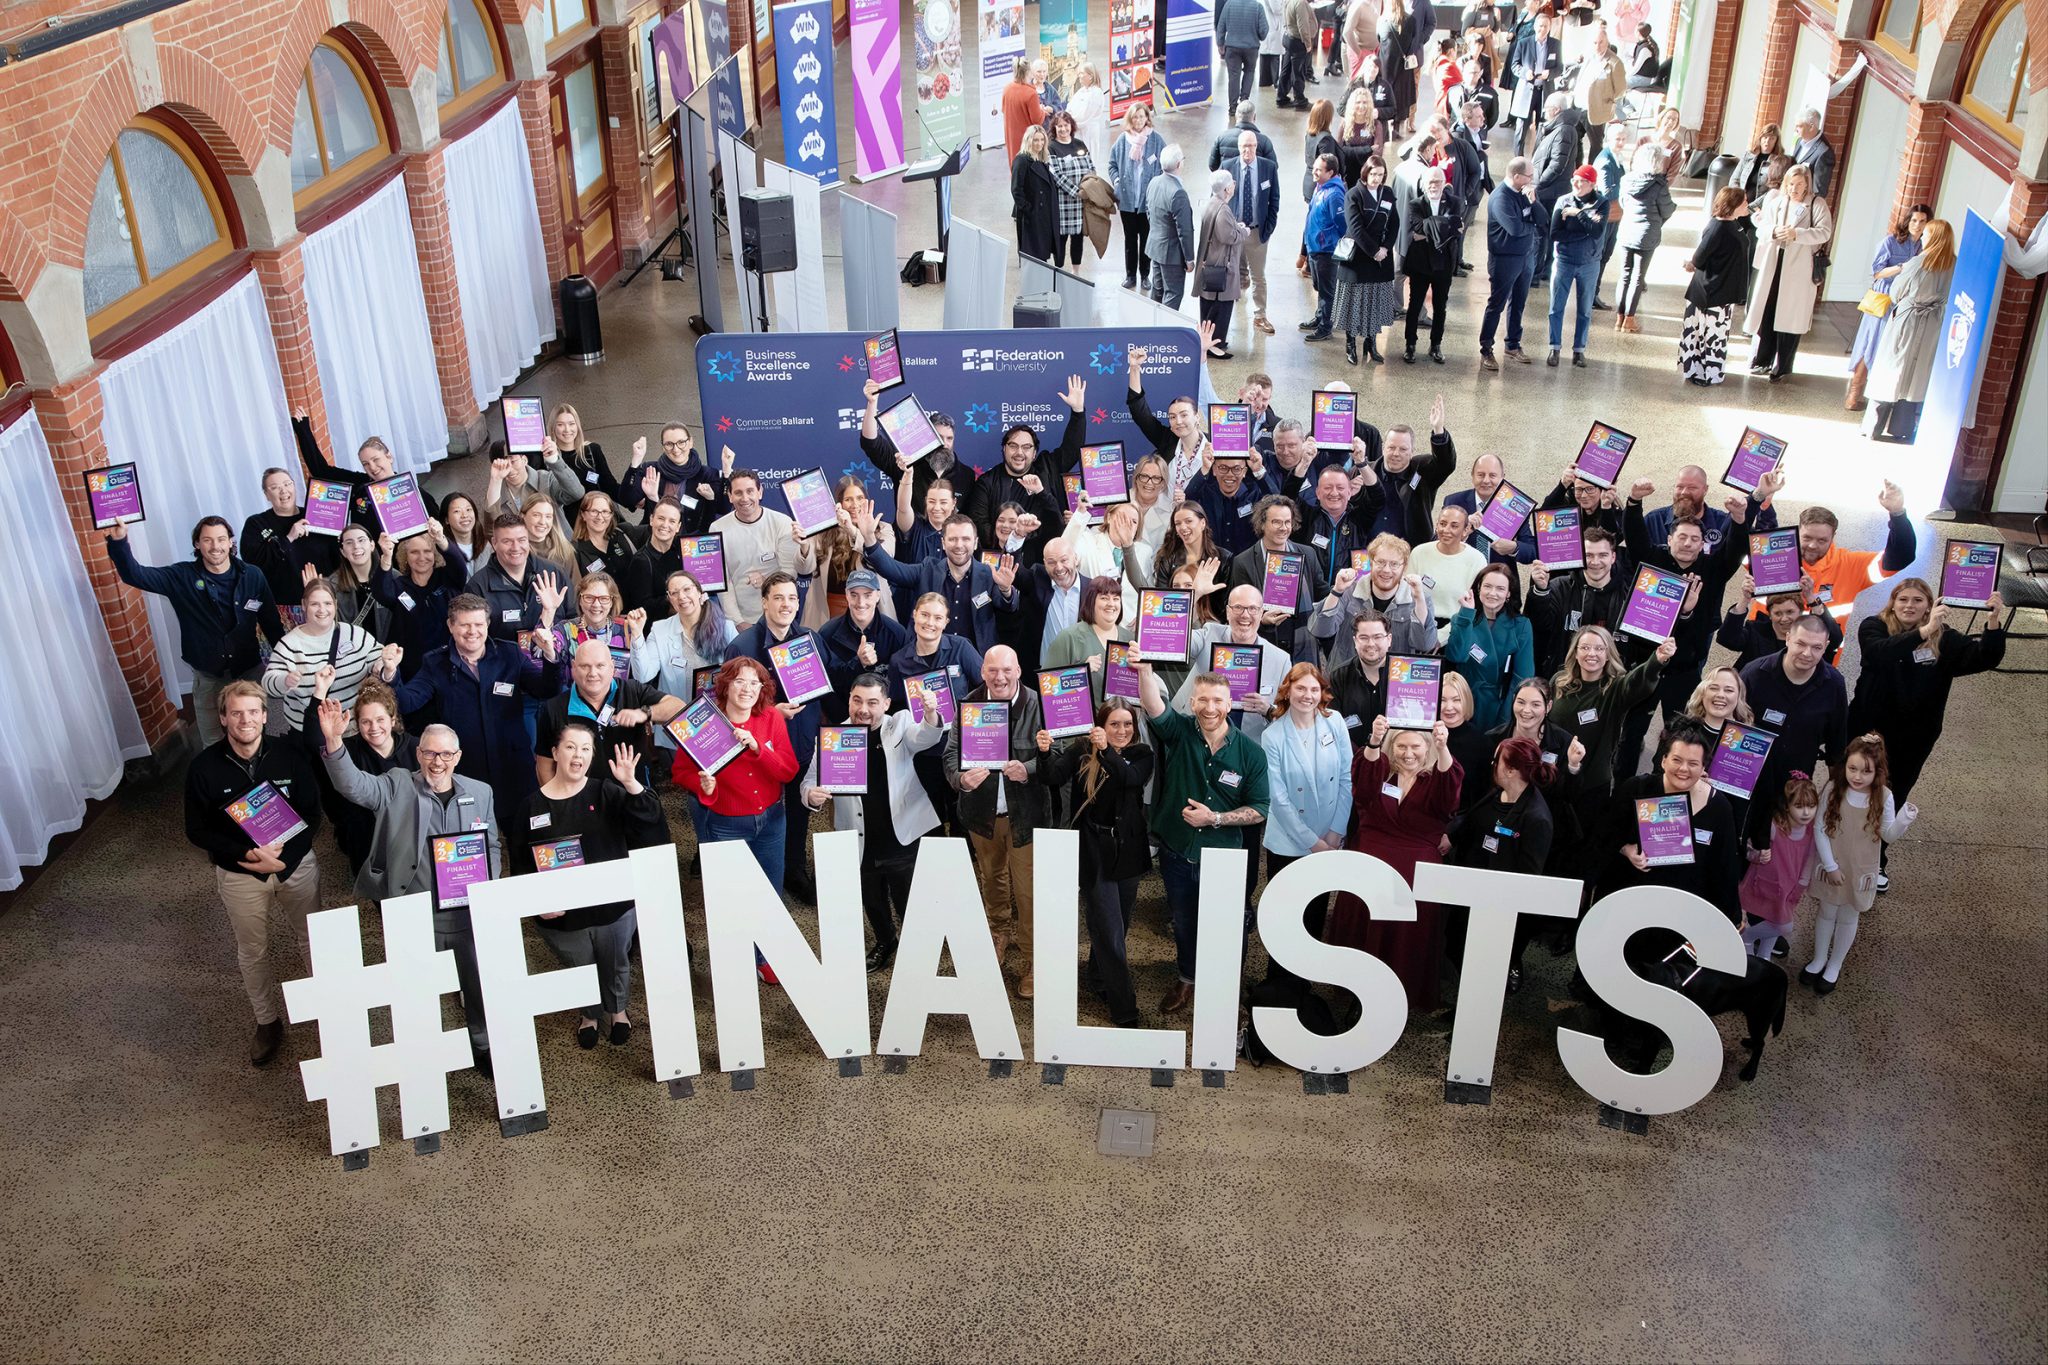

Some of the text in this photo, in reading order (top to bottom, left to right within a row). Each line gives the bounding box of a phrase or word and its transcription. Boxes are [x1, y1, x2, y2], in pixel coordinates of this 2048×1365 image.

[796, 21, 814, 33] WIN
[798, 61, 816, 73] WIN
[801, 100, 818, 112] WIN
[804, 138, 821, 150] WIN
[746, 350, 796, 360] Business
[995, 350, 1064, 360] Federation
[1128, 354, 1191, 364] ellence
[746, 360, 810, 370] Excellence
[995, 362, 1048, 373] University
[1127, 365, 1172, 374] wards
[747, 371, 792, 381] Awards
[1002, 402, 1051, 412] Business
[1002, 412, 1064, 422] Excellence
[1002, 423, 1046, 432] Ads
[1592, 448, 1615, 462] FINALIST
[1744, 454, 1767, 468] FINALIST
[752, 468, 809, 479] ederati
[1092, 468, 1115, 476] FINALIST
[100, 490, 129, 500] FINALIST
[315, 503, 340, 512] FINALIST
[1496, 505, 1516, 522] FINALIST
[690, 558, 714, 566] FINALIST
[1760, 556, 1788, 564] FINALIST
[1955, 570, 1986, 578] FINALIST
[1271, 578, 1292, 586] FINALIST
[1640, 597, 1669, 611] FINALIST
[786, 662, 812, 676] FINALIST
[1116, 669, 1139, 677] FINALI
[1397, 687, 1428, 695] FINALIST
[1052, 696, 1080, 705] FINALIST
[693, 724, 718, 746] FINALIST
[1724, 752, 1753, 766] FINALIST
[252, 805, 278, 826] FINALIST
[1649, 824, 1680, 834] FINALIST
[446, 864, 477, 873] FINALIST
[282, 828, 1748, 1157] #FINALISTS
